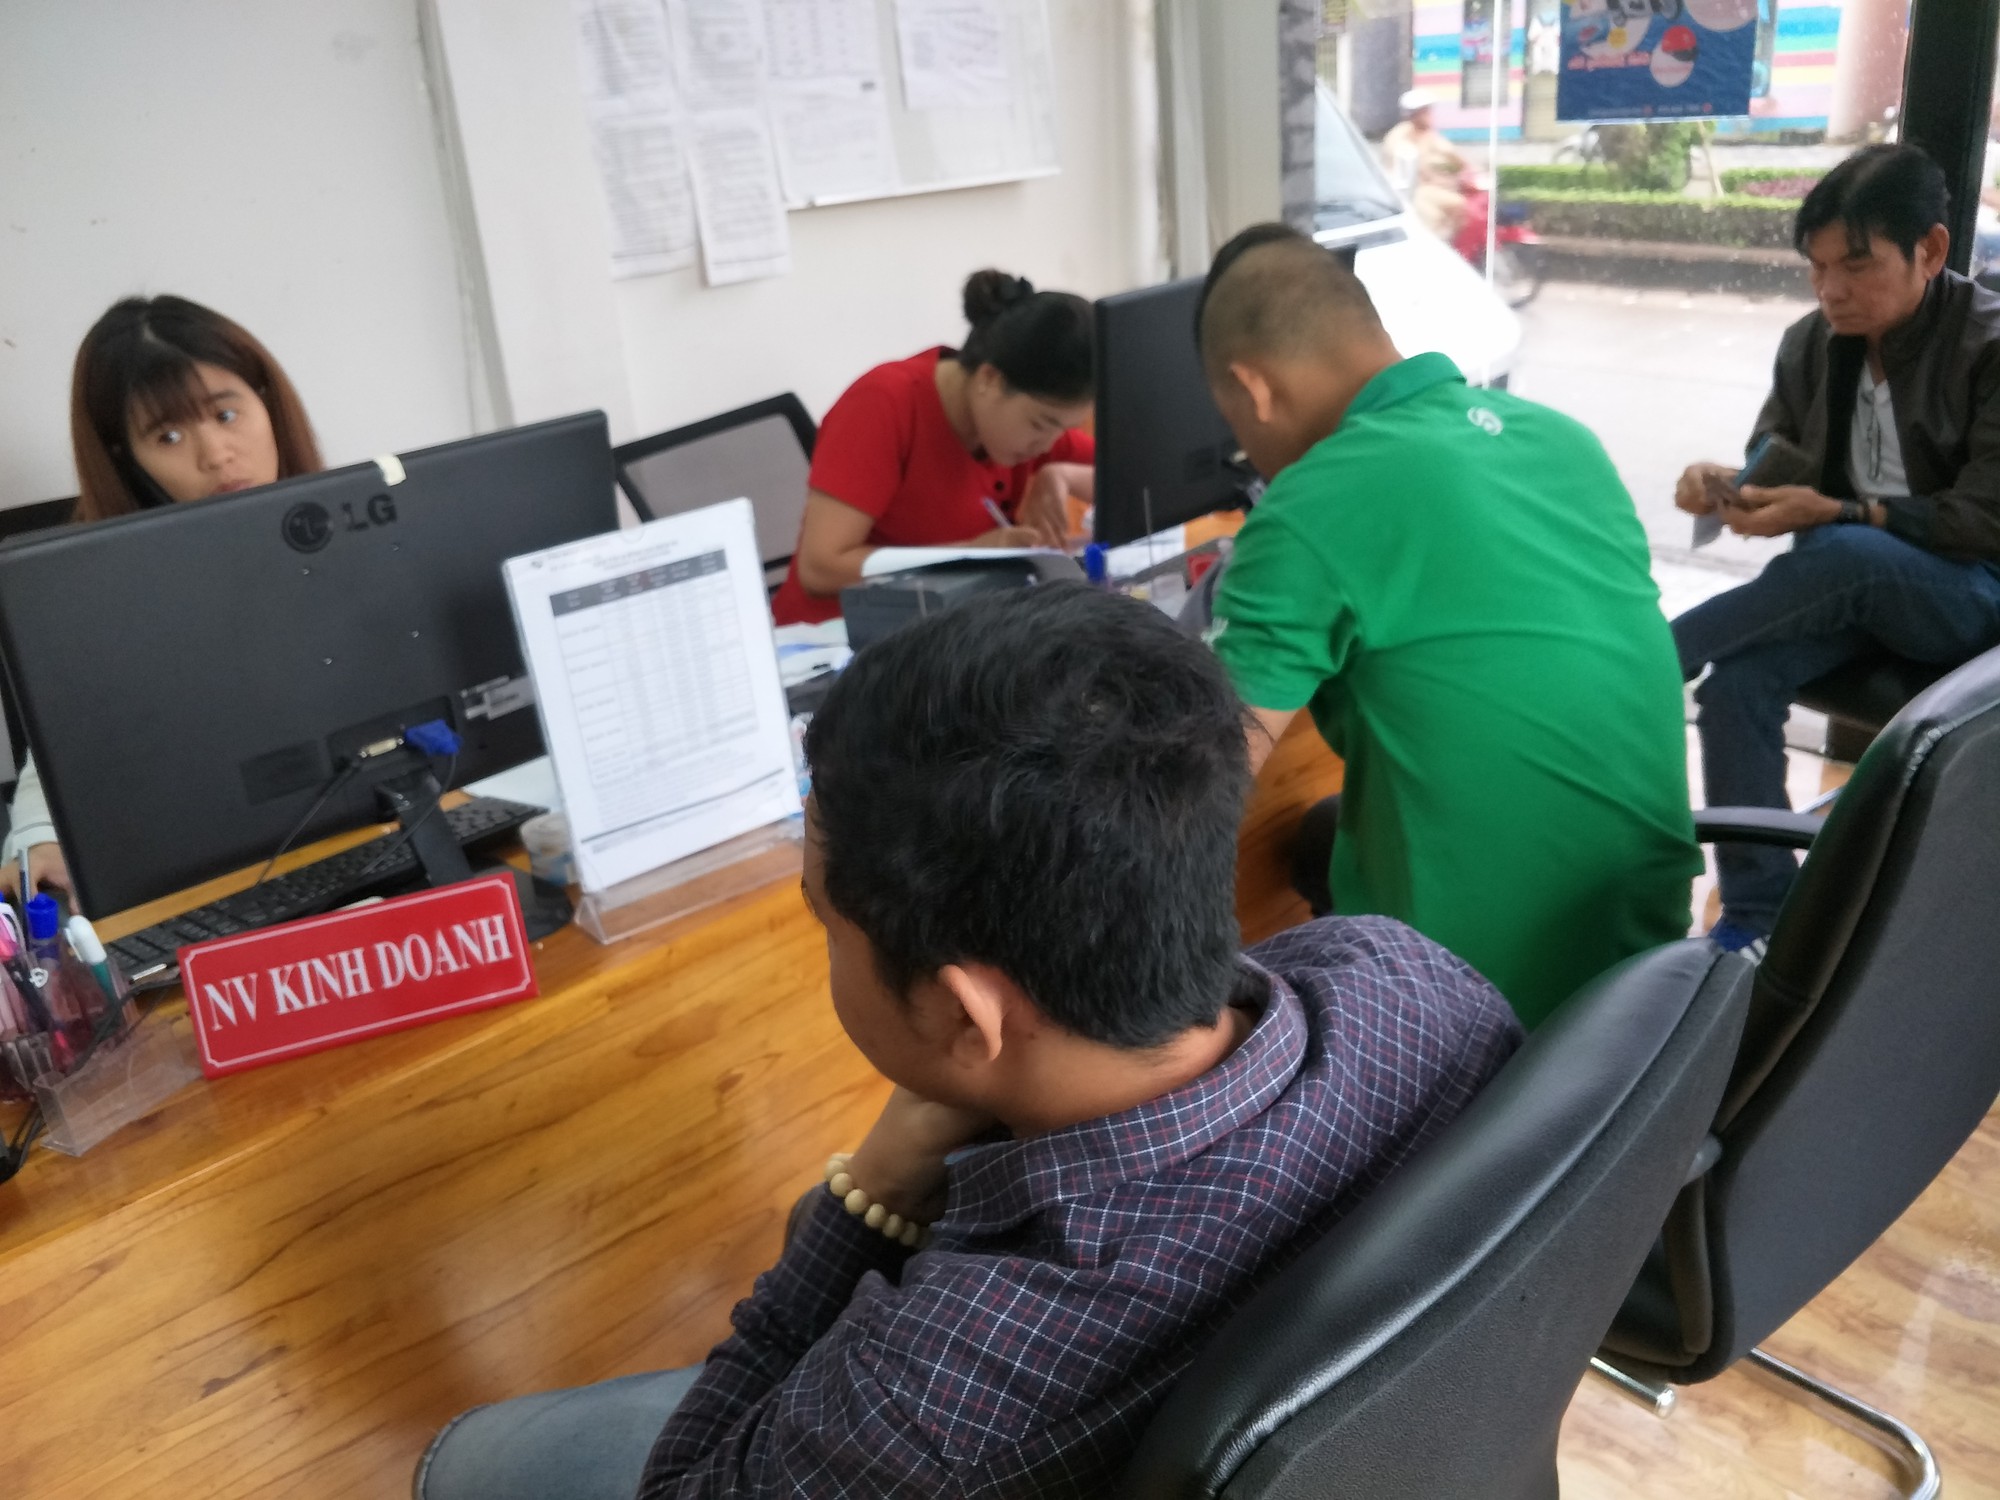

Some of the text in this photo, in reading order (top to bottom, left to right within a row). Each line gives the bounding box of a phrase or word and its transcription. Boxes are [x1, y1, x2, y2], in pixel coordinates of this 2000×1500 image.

[342, 493, 397, 532] LG
[203, 914, 513, 1031] NV KINH DOANH
